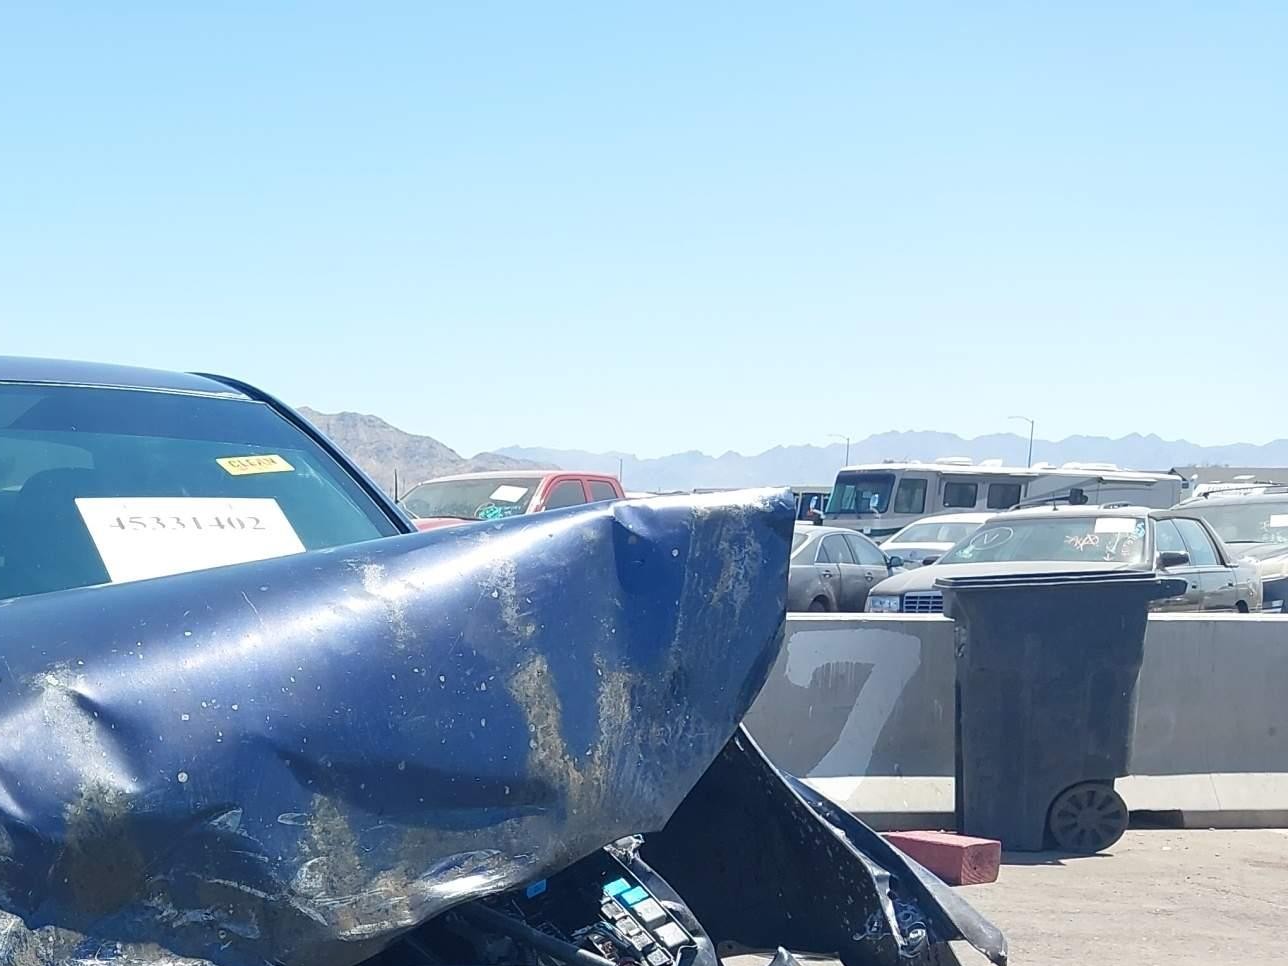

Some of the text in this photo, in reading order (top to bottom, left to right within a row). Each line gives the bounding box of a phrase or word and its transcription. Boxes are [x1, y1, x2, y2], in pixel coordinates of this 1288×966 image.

[227, 457, 277, 468] CLEAN
[110, 515, 266, 531] 45331402
[785, 628, 922, 801] 7
